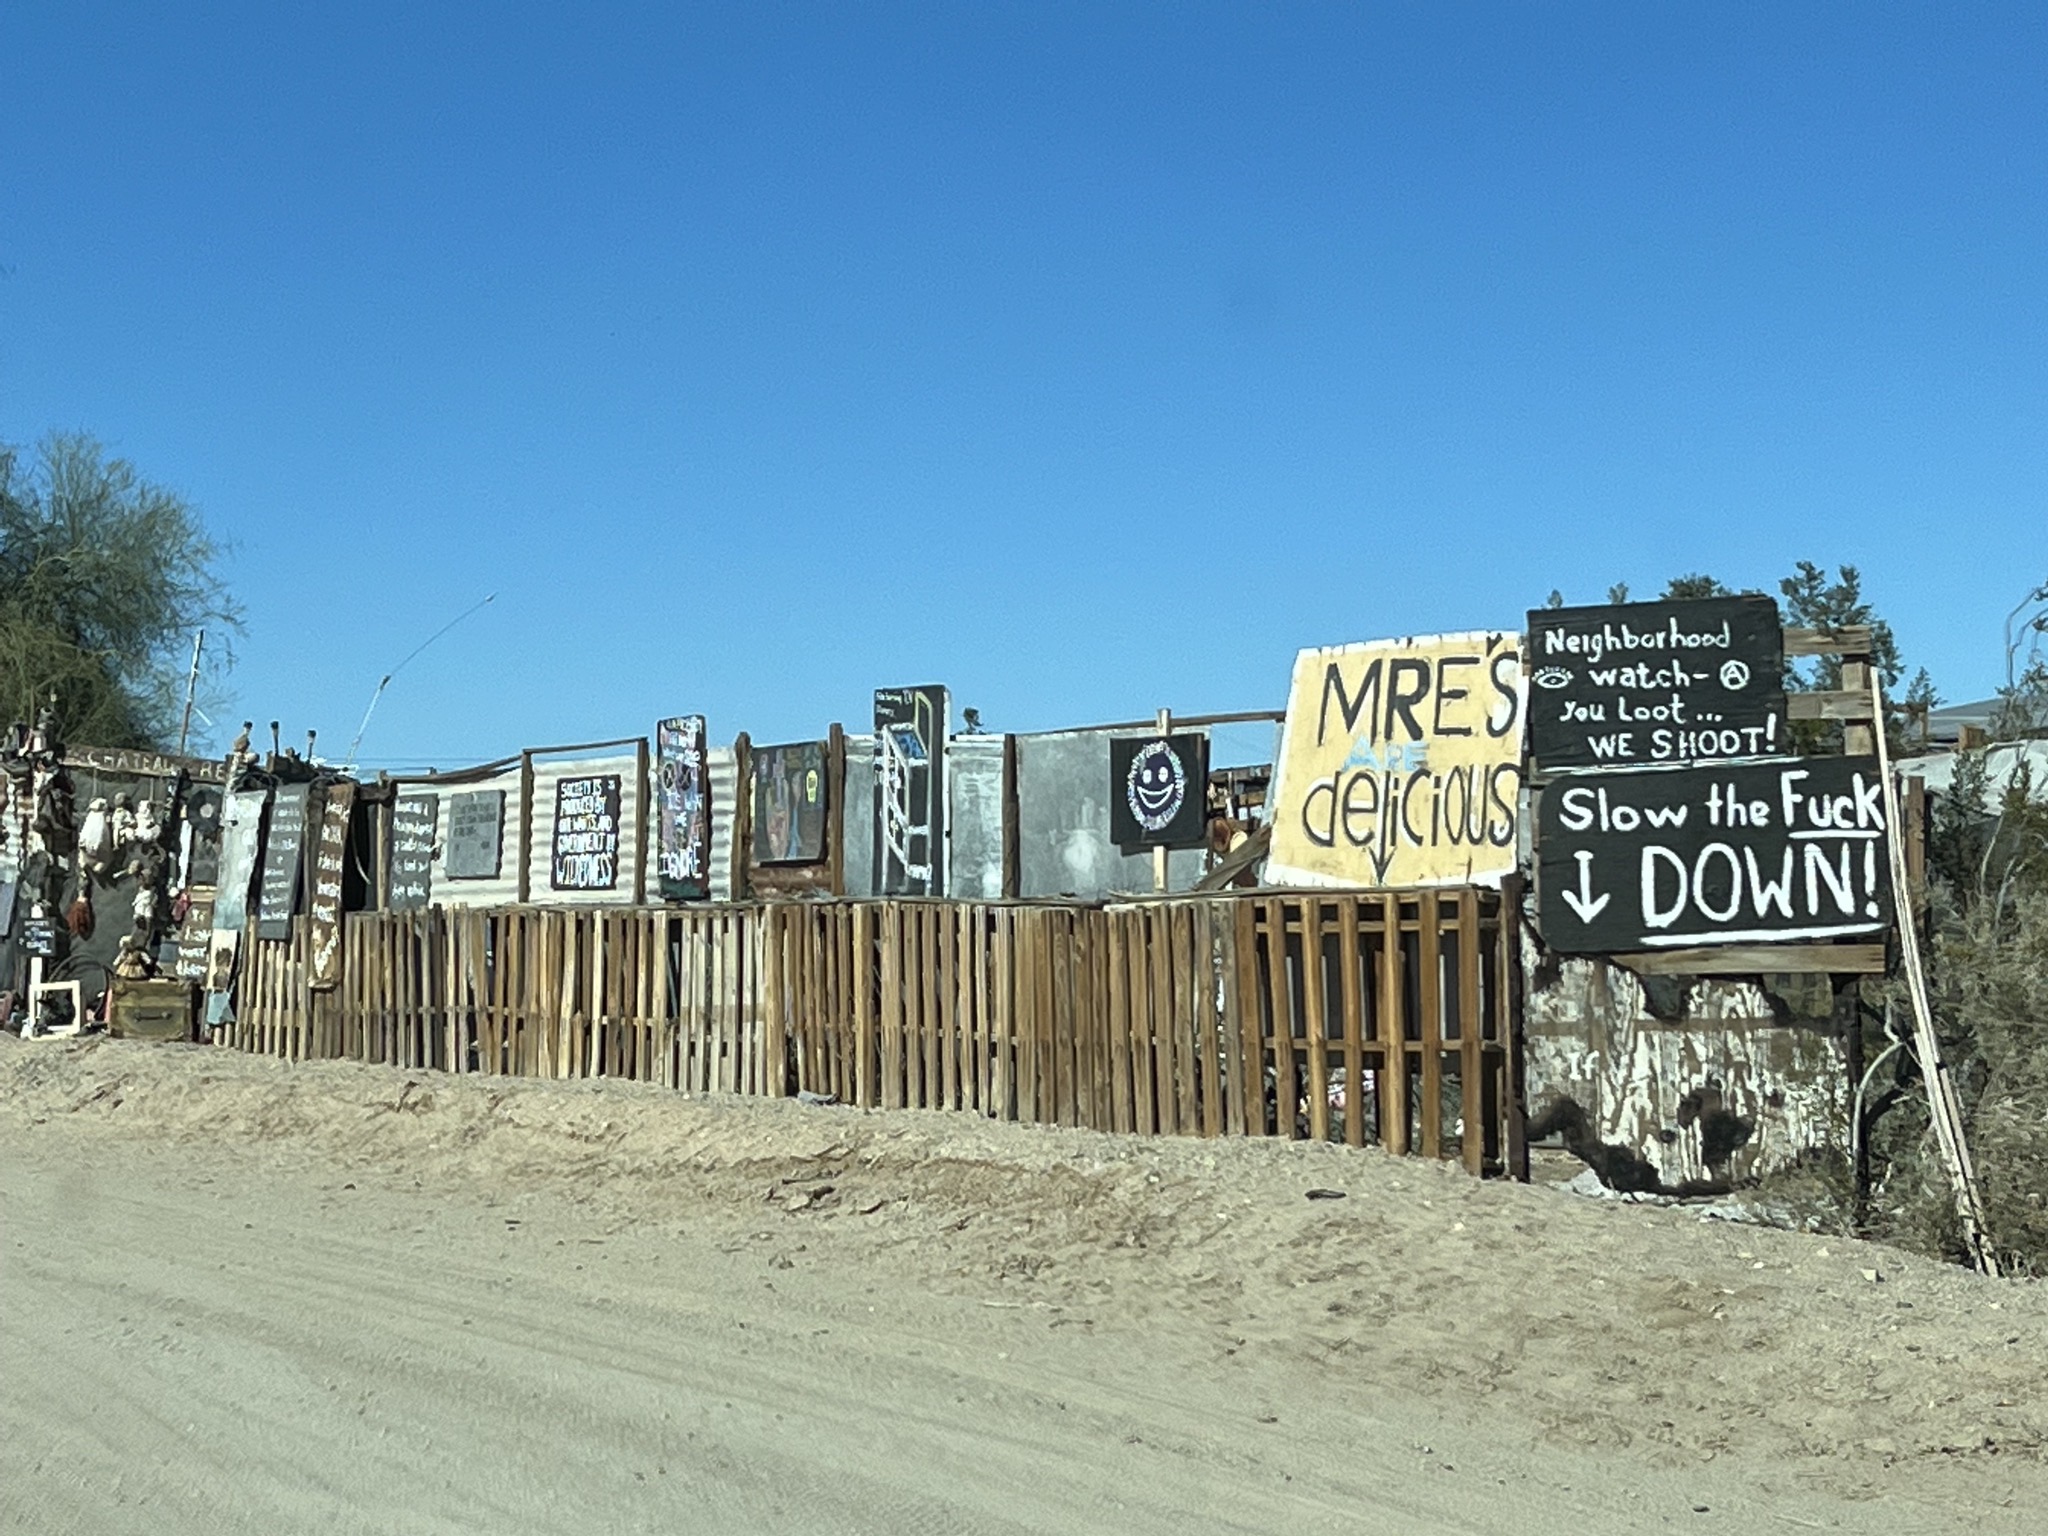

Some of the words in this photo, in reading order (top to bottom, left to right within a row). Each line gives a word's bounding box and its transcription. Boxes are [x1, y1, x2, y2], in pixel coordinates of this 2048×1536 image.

[1545, 617, 1731, 662] Neighborhood
[1317, 632, 1519, 747] MRE'S
[1559, 701, 1605, 722] you
[1588, 733, 1634, 758] WE
[1650, 713, 1776, 759] SHOOT!
[1303, 762, 1520, 849] delicious
[1559, 787, 1688, 831] Slow
[1705, 783, 1771, 828] the
[1641, 839, 1881, 928] DOWN!
[1568, 1050, 1600, 1081] If
